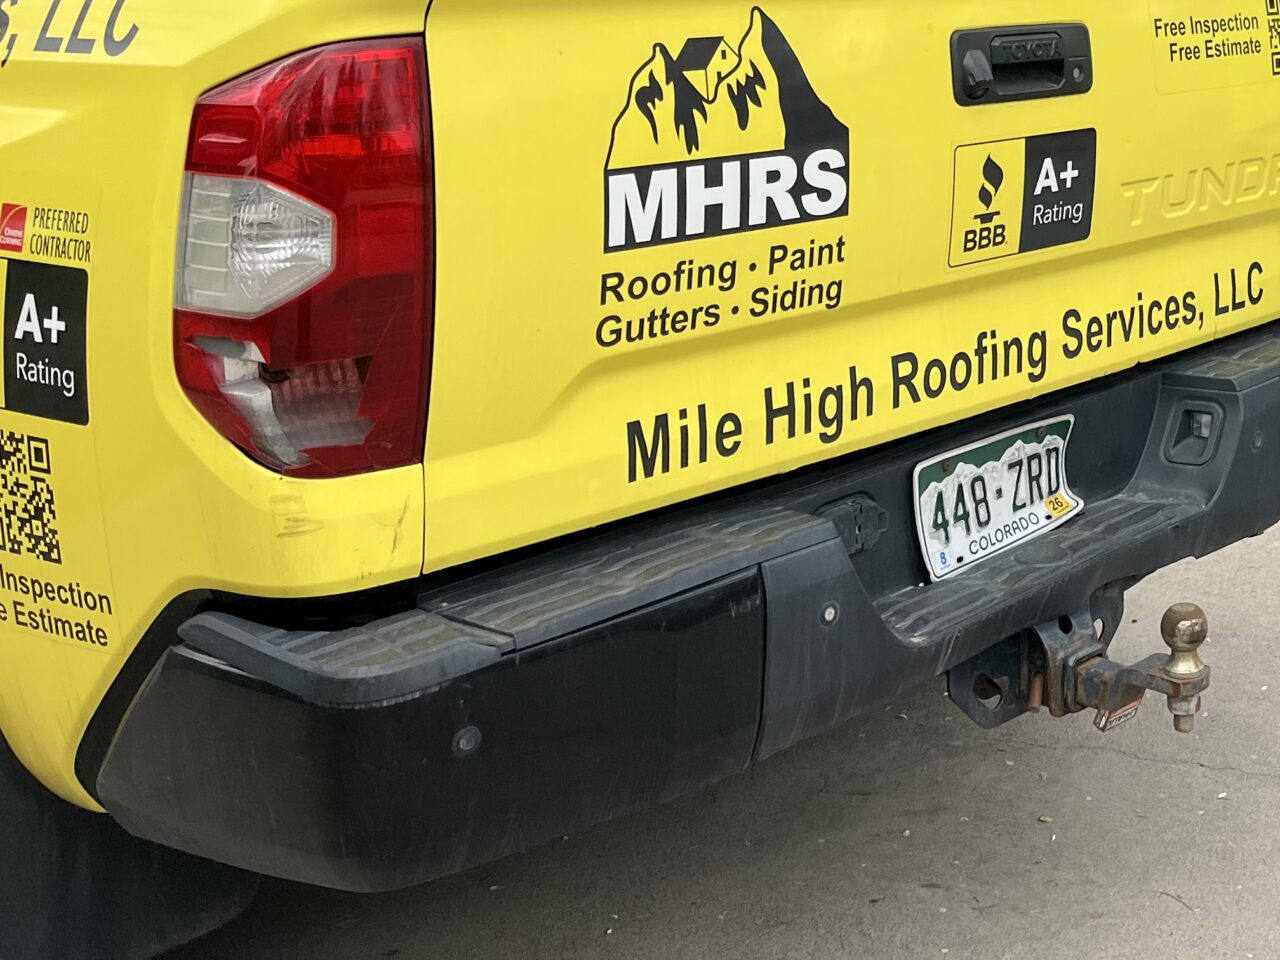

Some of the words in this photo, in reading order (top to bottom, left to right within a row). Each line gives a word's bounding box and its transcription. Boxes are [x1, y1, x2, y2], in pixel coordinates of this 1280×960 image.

[1153, 18, 1186, 38] Free
[1189, 12, 1259, 38] Inspection
[1000, 39, 1062, 60] TOYOTA
[1169, 42, 1201, 63] Free
[1205, 37, 1262, 59] Estimate
[1033, 157, 1079, 196] A+
[608, 148, 847, 248] MHRS
[1032, 201, 1084, 226] Rating
[33, 207, 89, 234] PREFERRED
[963, 224, 1006, 253] BBB
[30, 233, 91, 263] CONTRACTOR
[600, 259, 737, 306] Roofing
[768, 235, 846, 275] Paint
[14, 293, 66, 344] A+
[595, 303, 721, 348] Gutters
[749, 279, 843, 318] Siding
[16, 352, 75, 397] Rating
[626, 403, 742, 483] Mile
[764, 365, 874, 445] High
[891, 329, 1047, 409] Roofing
[1061, 291, 1205, 359] Services,
[1213, 261, 1264, 317] LLC
[1048, 497, 1064, 511] 26
[969, 512, 1040, 555] COLORADO
[940, 551, 947, 565] 8
[0, 563, 112, 615] Inspection
[13, 600, 108, 647] Estimate
